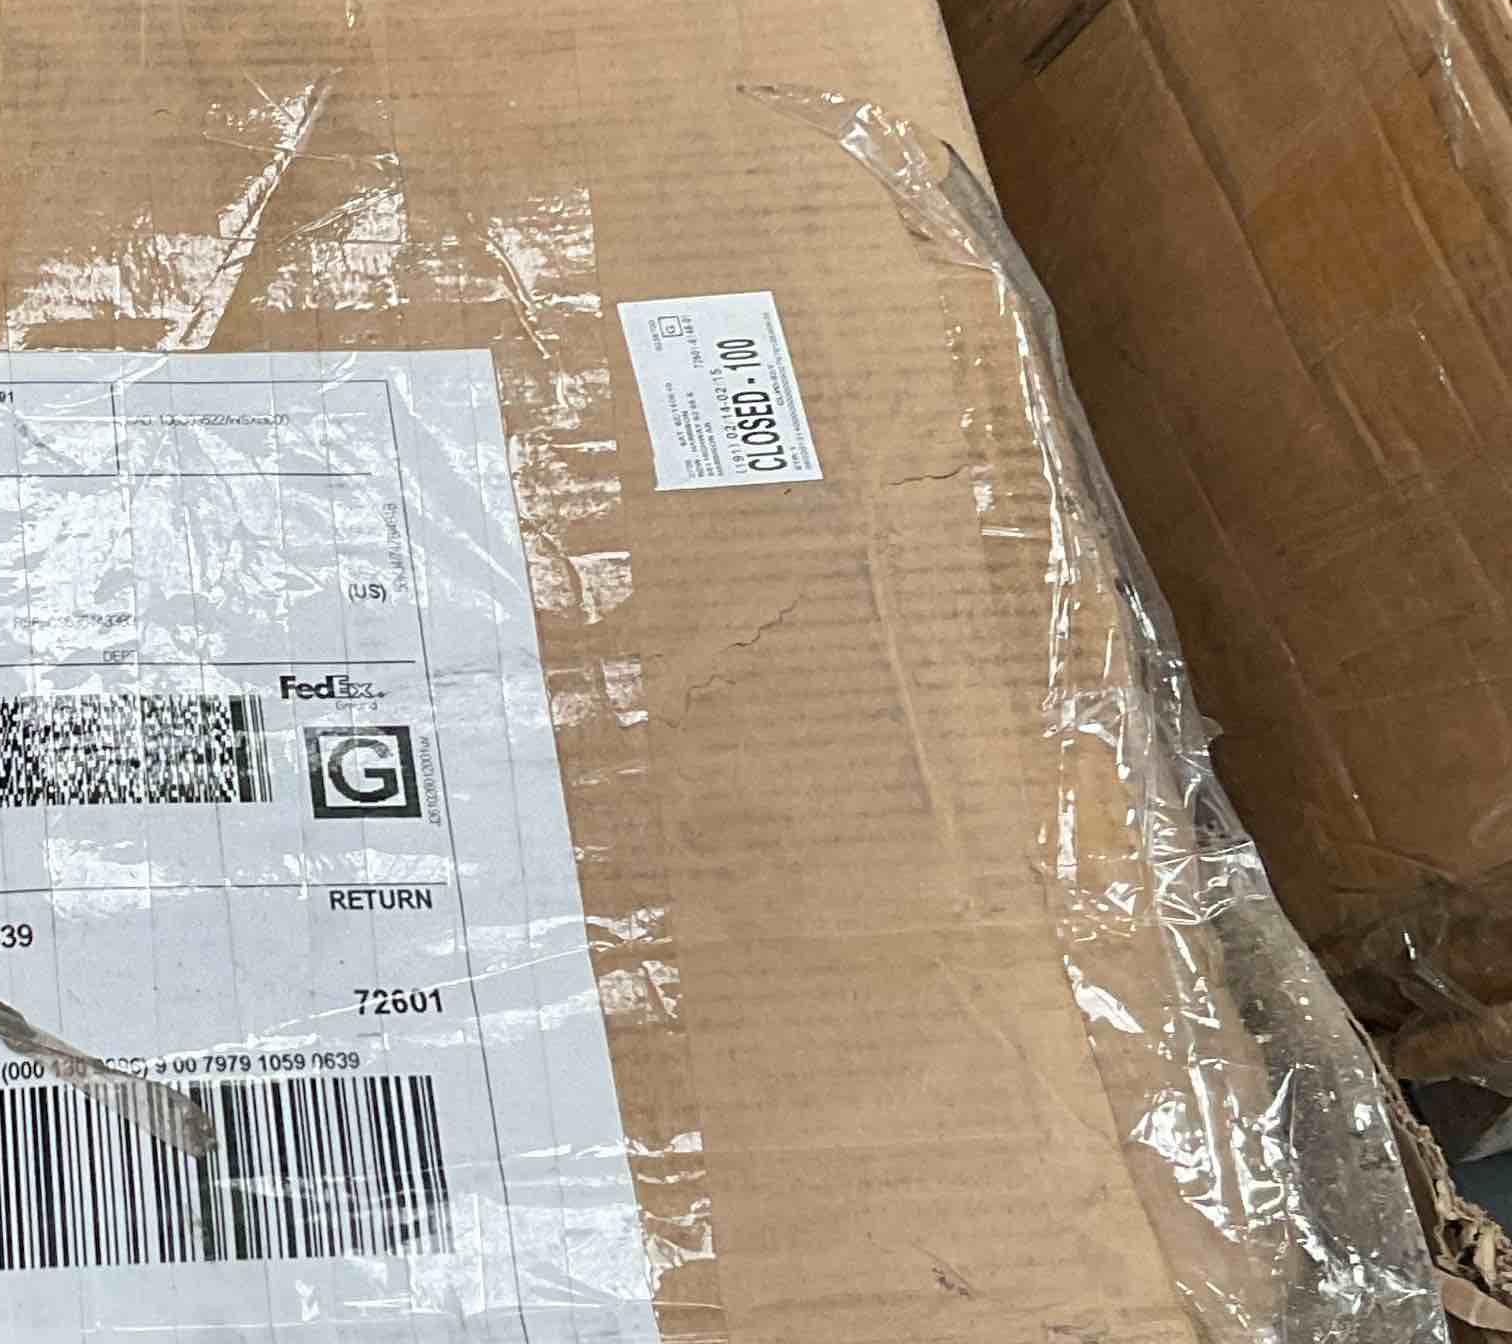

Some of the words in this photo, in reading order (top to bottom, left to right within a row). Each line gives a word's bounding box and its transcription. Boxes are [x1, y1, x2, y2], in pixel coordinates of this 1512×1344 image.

[716, 338, 762, 372] 100
[732, 390, 788, 473] CLOSED
[348, 583, 387, 603] (US)
[328, 737, 399, 803] G
[330, 889, 433, 910] RETURN
[354, 987, 444, 1016] 72601
[1, 1058, 45, 1086] (000
[155, 1055, 167, 1074] 9
[173, 1056, 198, 1074] 00
[204, 1053, 252, 1073] 7979
[258, 1051, 306, 1071] 1059
[312, 1050, 361, 1070] 0639
